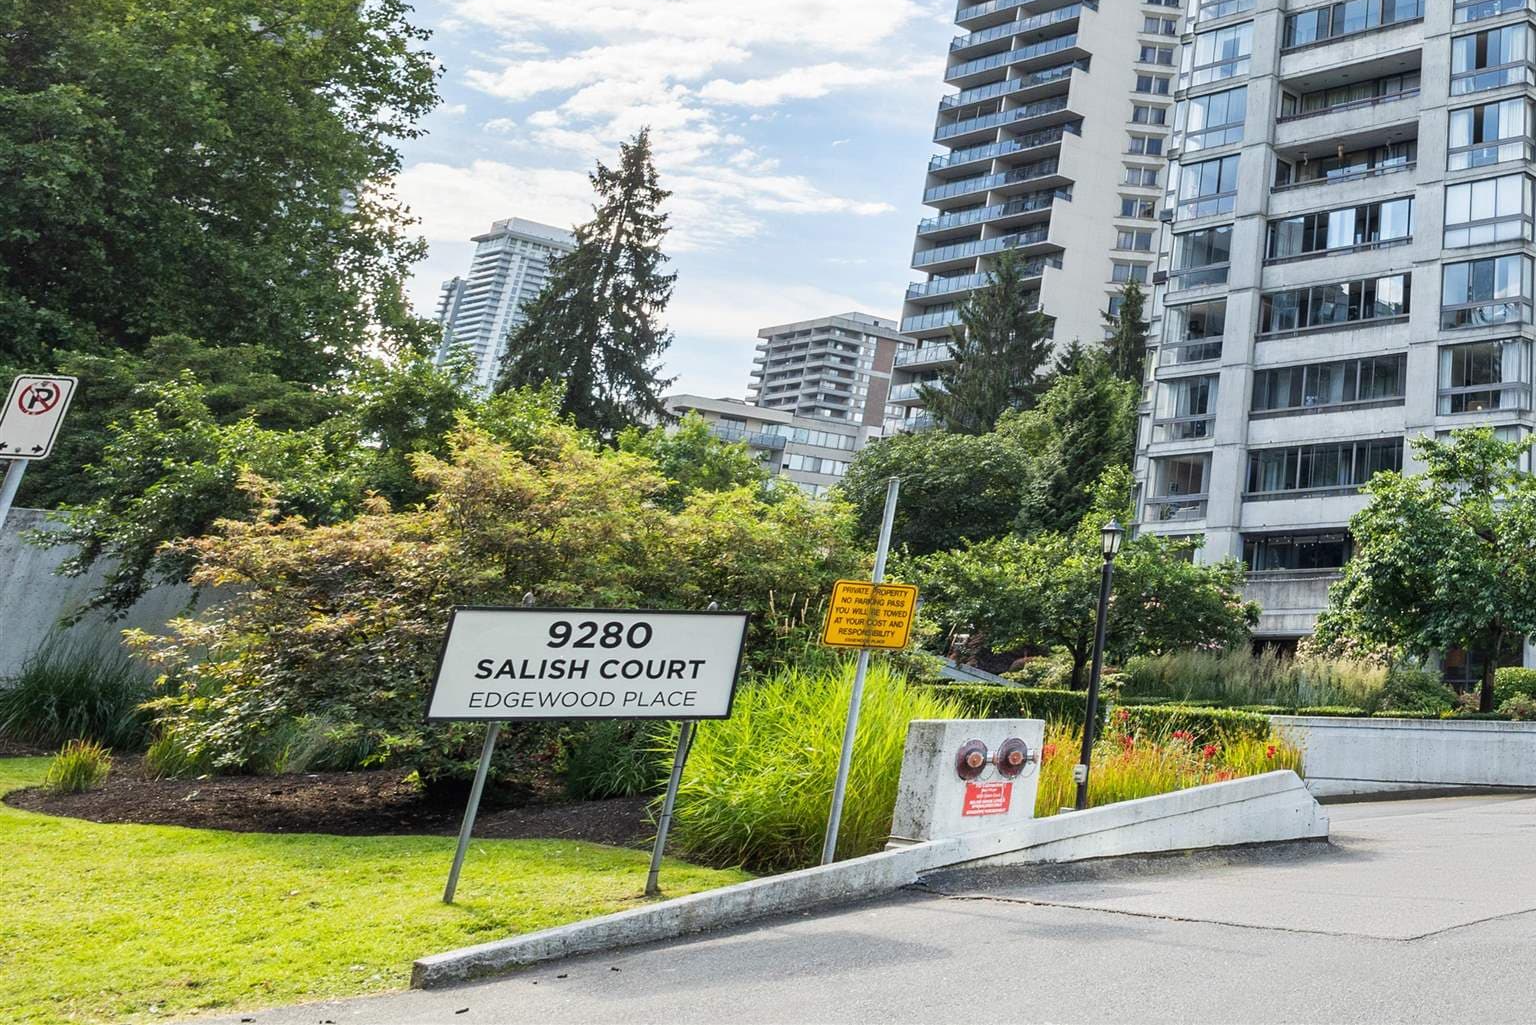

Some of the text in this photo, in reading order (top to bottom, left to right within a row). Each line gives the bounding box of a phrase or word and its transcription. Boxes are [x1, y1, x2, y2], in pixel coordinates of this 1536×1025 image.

[843, 586, 908, 597] PRIVATE PROPERTY
[855, 598, 885, 606] PARKING
[883, 610, 907, 618] TOWED
[866, 619, 887, 627] COST
[889, 620, 904, 628] AND
[546, 620, 654, 650] 9280
[474, 658, 706, 680] SALISH COURT
[468, 690, 698, 708] EDGEWOOD PLACE
